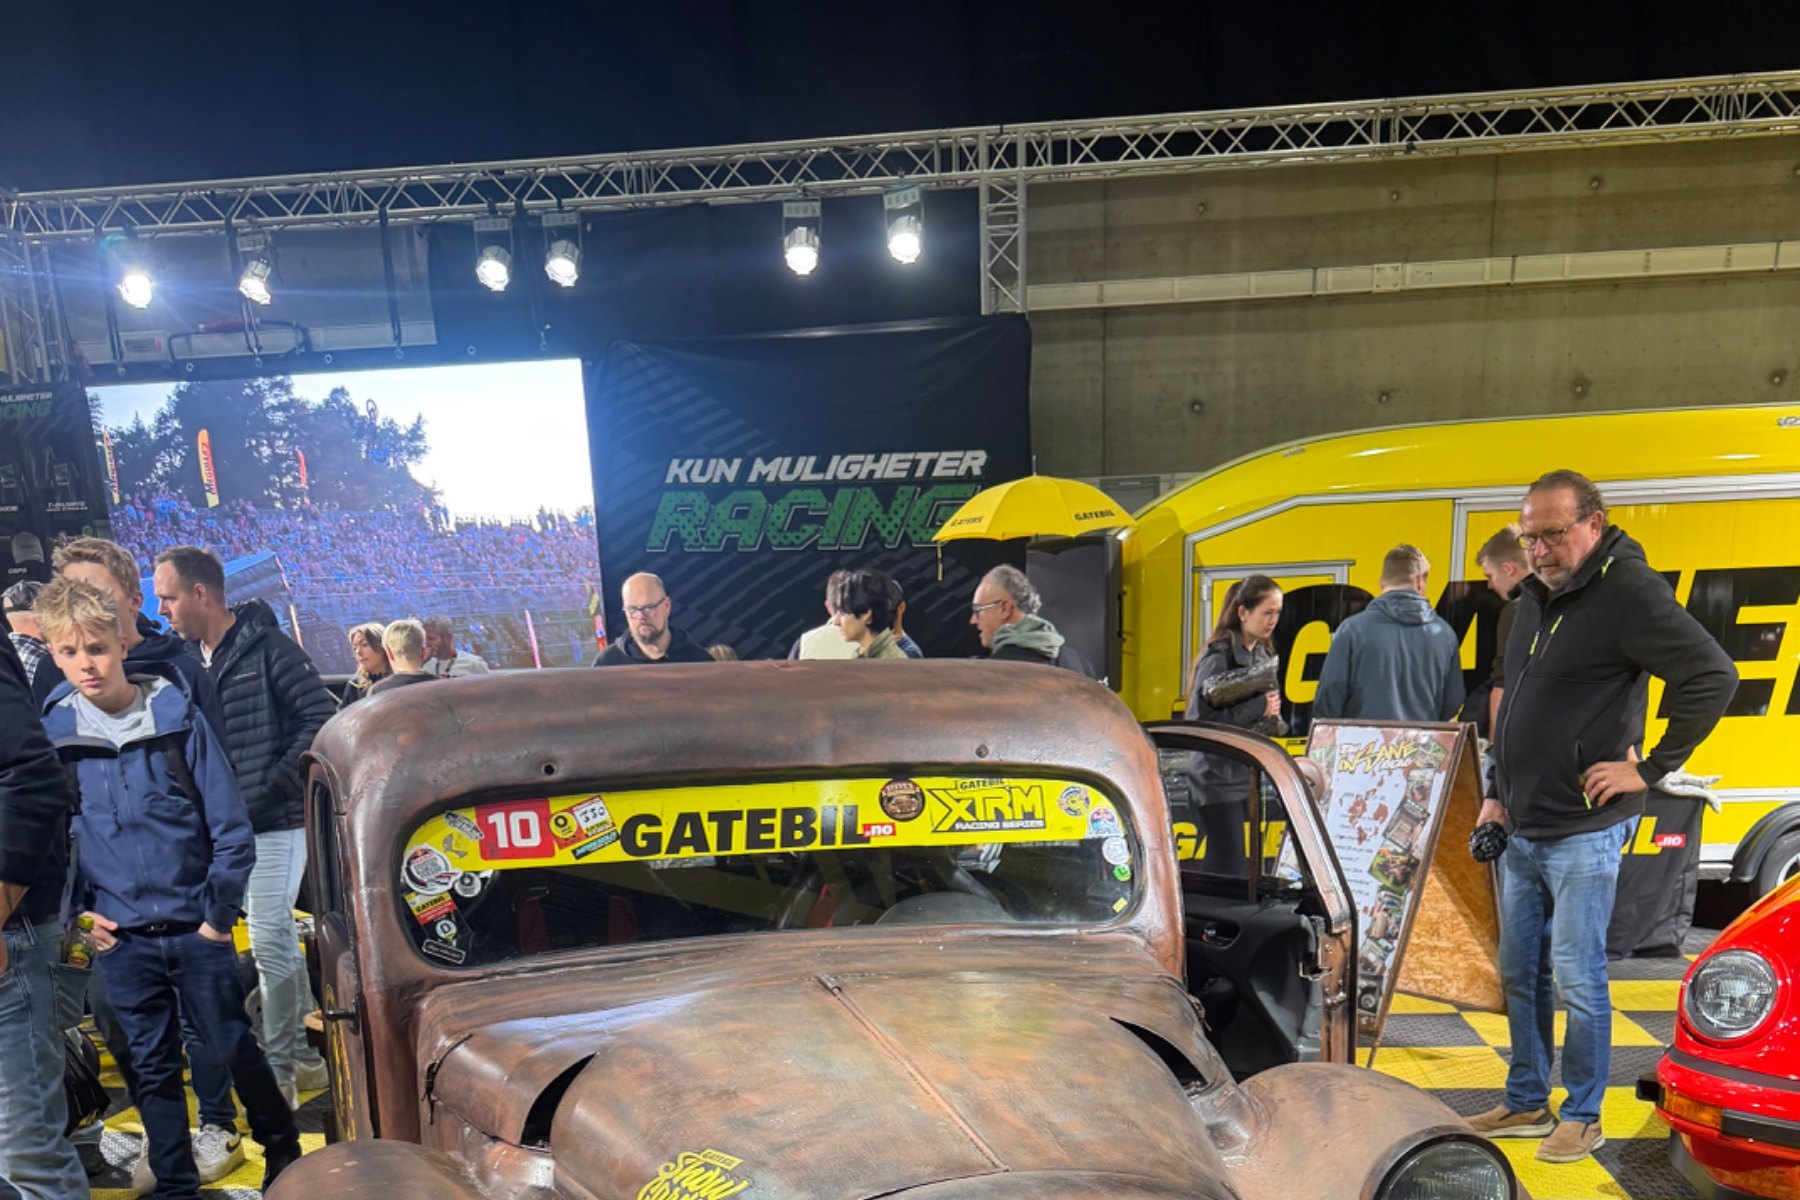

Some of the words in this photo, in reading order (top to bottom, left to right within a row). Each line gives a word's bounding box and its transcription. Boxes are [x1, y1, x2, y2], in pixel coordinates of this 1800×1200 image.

[0, 402, 51, 421] CING
[664, 457, 741, 484] KUN
[748, 450, 988, 484] MULIGHETER
[645, 484, 983, 552] RACING
[1074, 509, 1116, 522] GATEBIL
[487, 810, 541, 848] 10
[620, 805, 870, 856] GATEBIL
